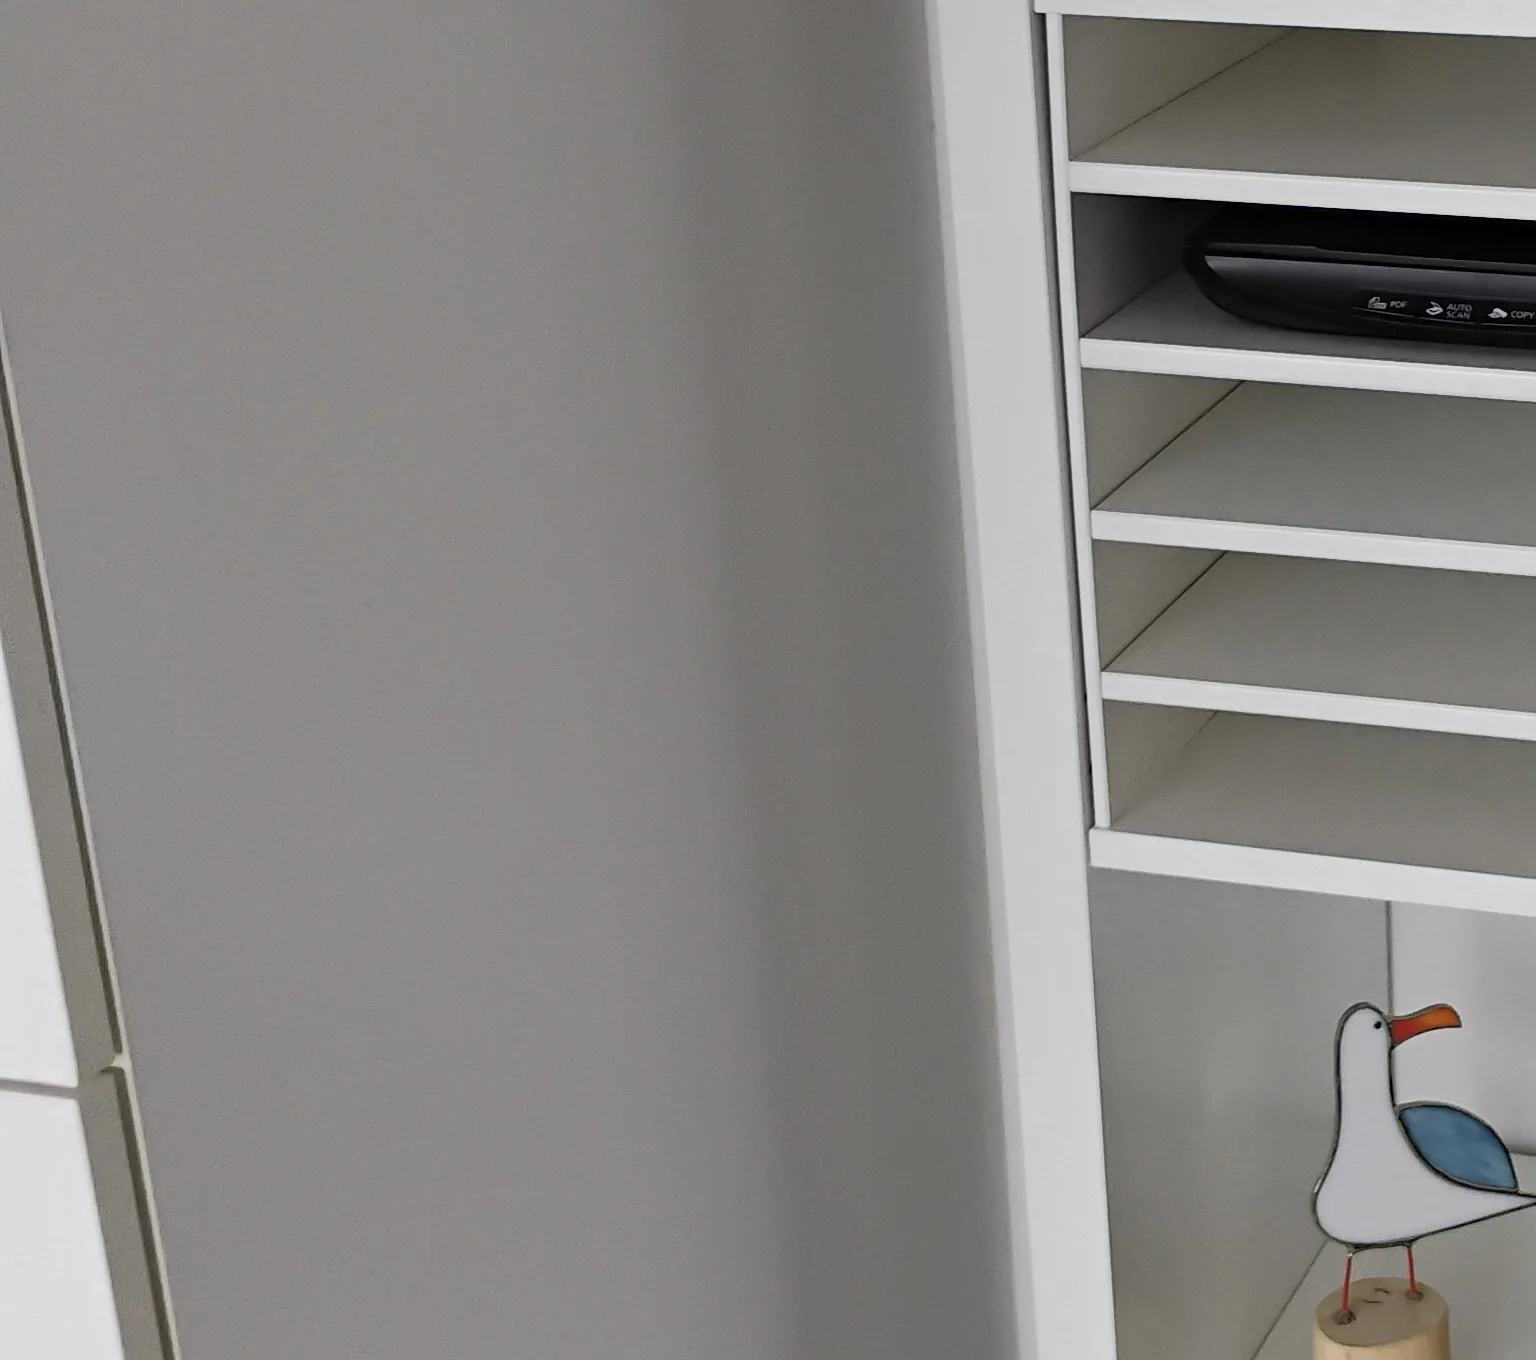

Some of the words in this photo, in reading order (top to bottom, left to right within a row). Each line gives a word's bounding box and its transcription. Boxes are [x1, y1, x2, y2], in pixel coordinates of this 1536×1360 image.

[1390, 300, 1407, 309] PDF
[1447, 303, 1473, 312] AUTO
[1446, 311, 1471, 320] SCAN
[1510, 311, 1535, 320] COPY
